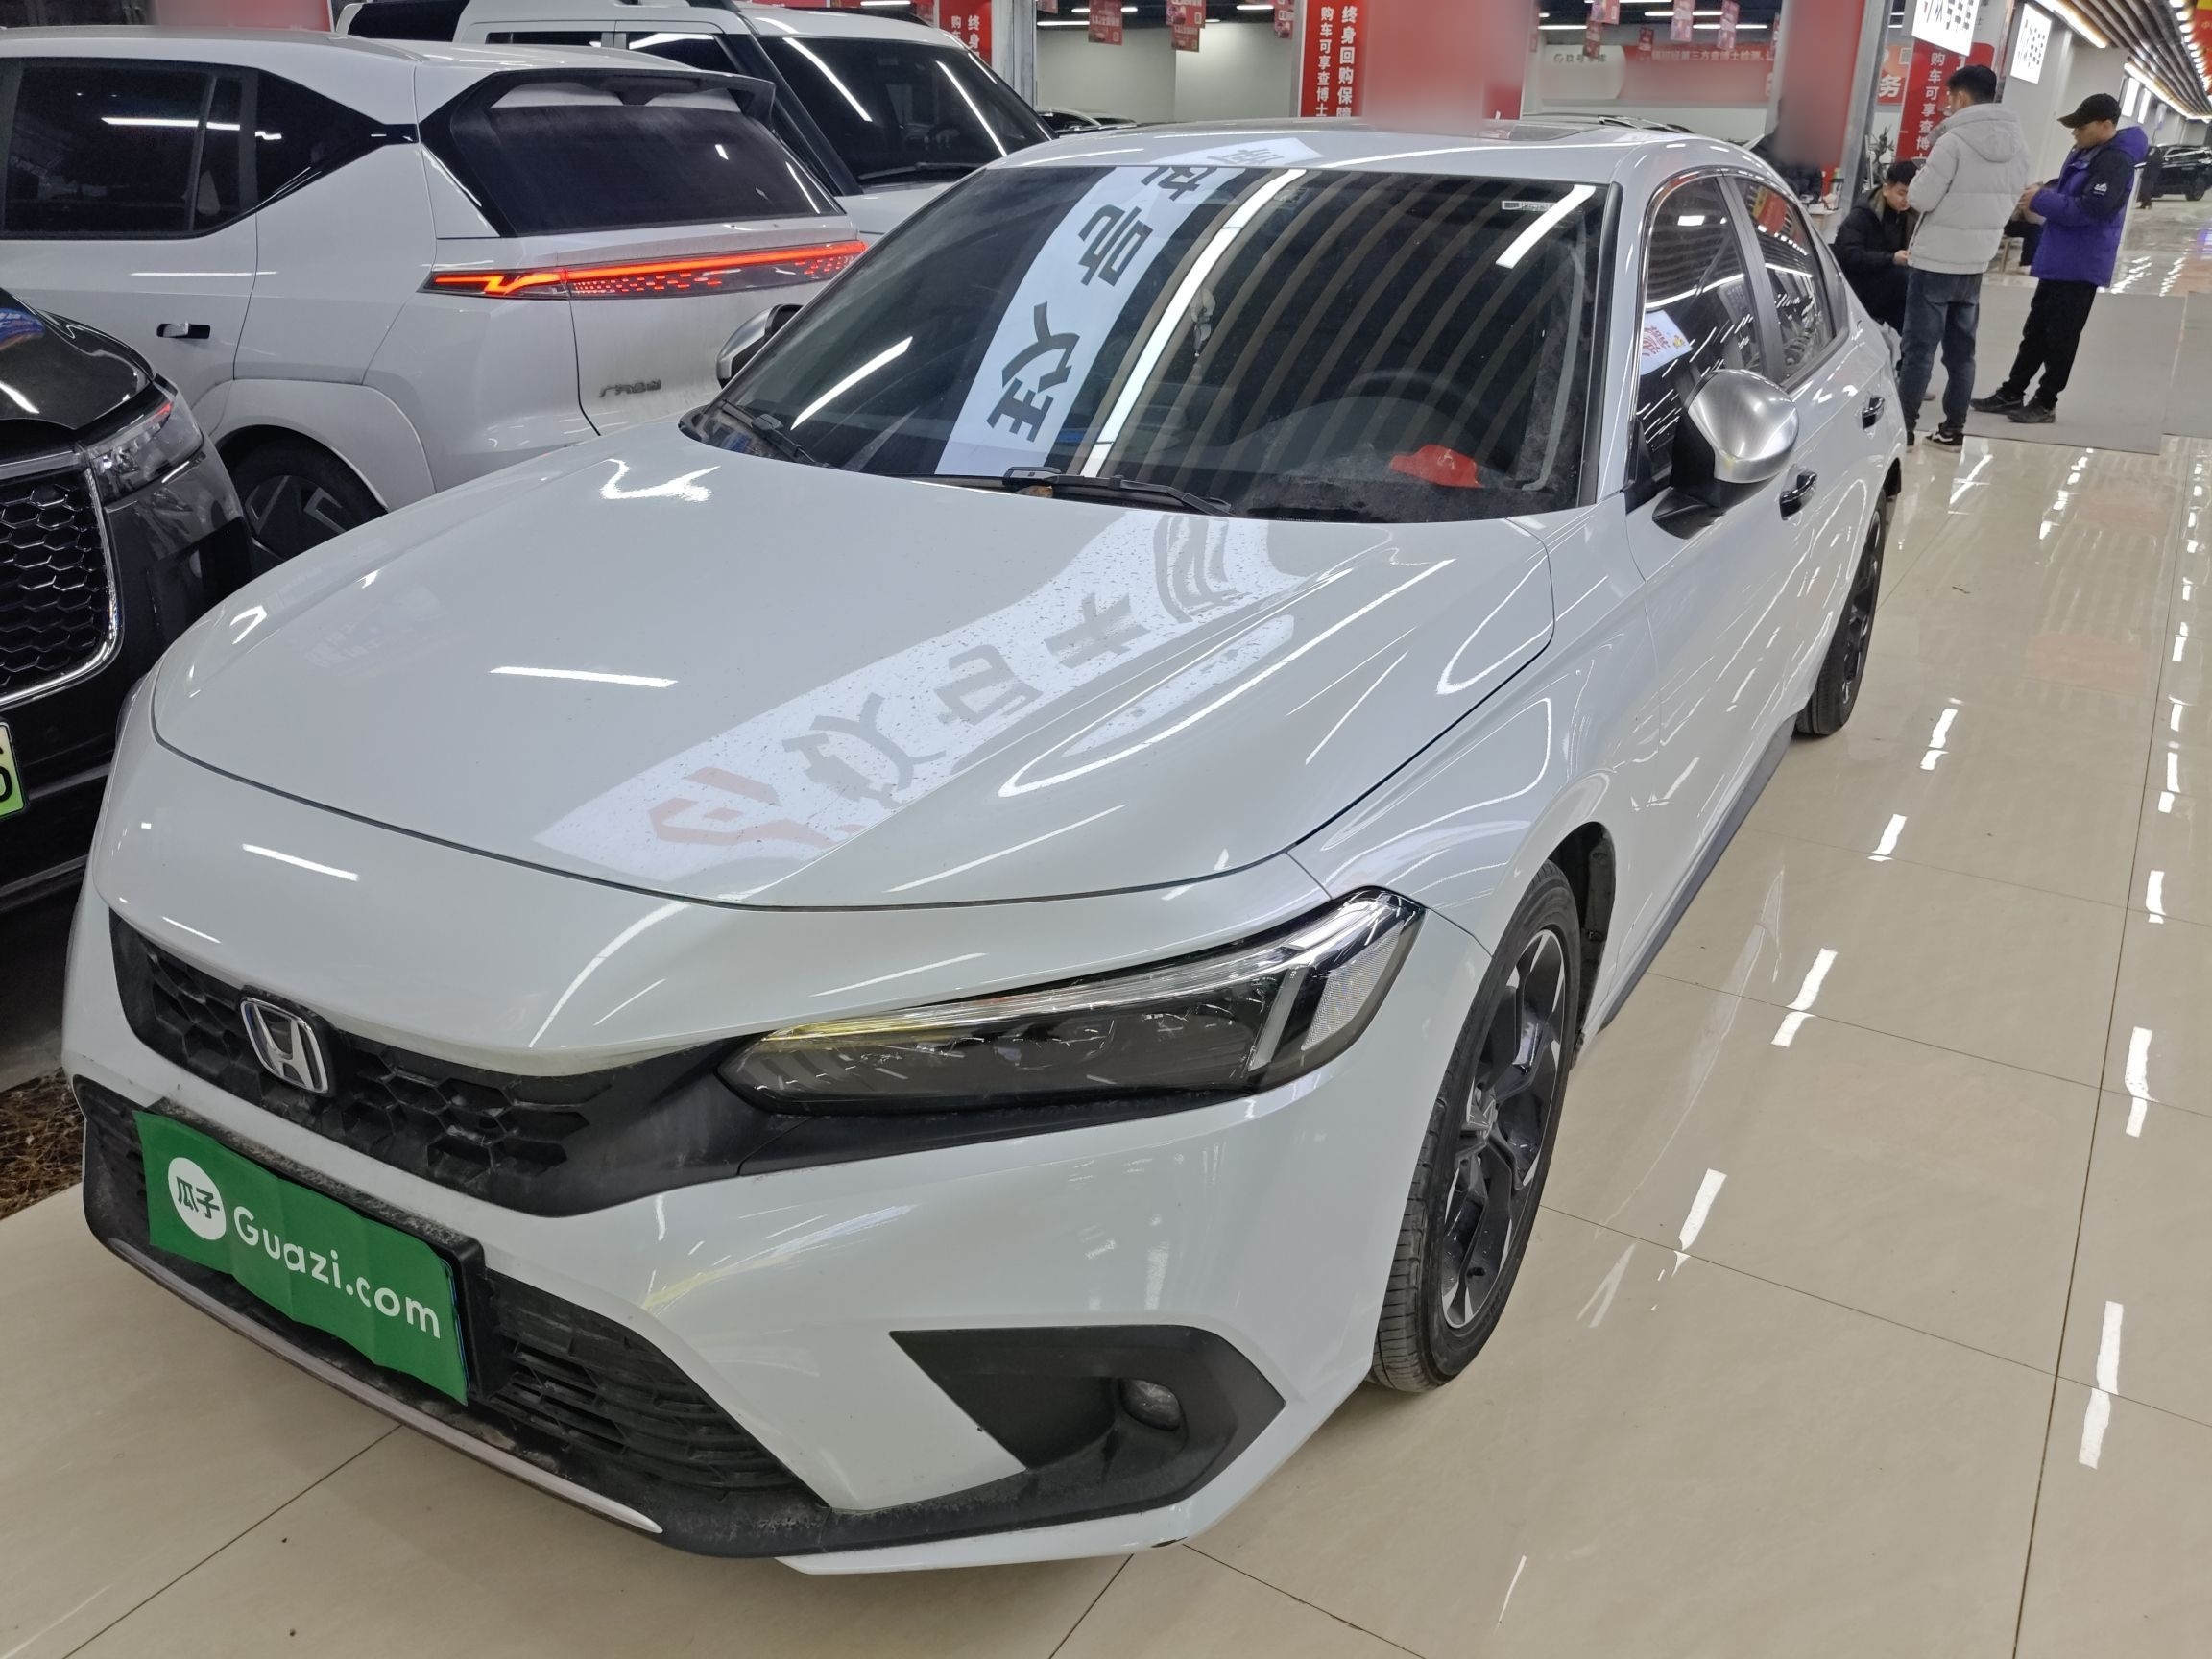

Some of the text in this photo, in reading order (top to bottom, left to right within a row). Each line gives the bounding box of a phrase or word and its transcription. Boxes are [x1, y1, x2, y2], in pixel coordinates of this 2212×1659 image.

[1315, 6, 1334, 117] 购车可享查博士
[1879, 74, 1902, 98] 务
[175, 1176, 221, 1220] 瓜子
[233, 1206, 441, 1339] Guazi.com
